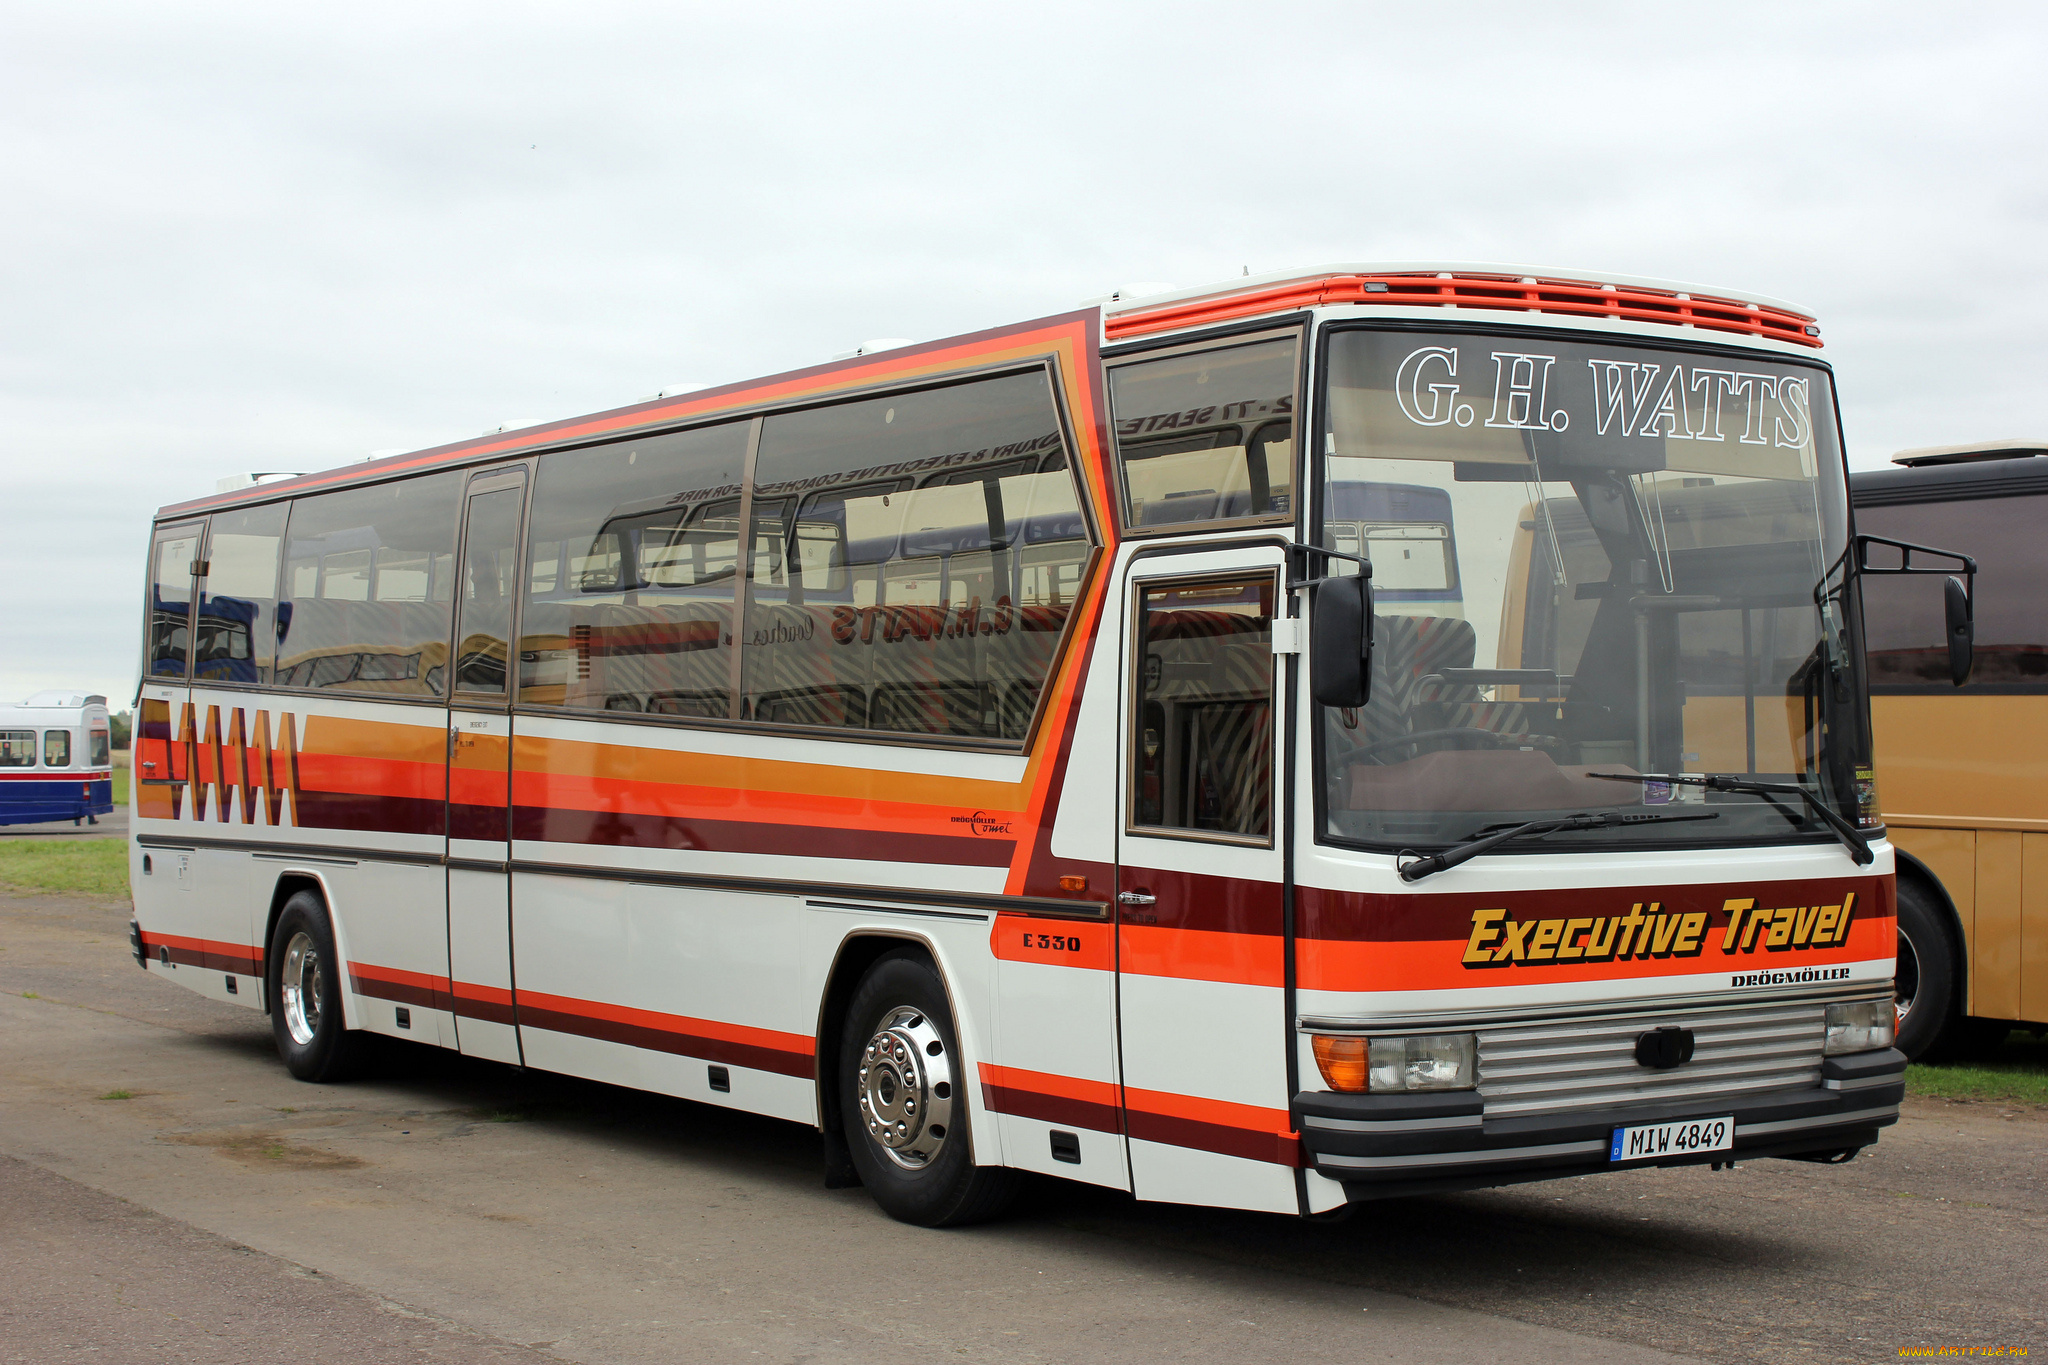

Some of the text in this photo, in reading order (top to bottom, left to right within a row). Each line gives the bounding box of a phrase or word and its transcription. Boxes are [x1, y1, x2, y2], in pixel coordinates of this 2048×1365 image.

[1587, 358, 1810, 449] WATTS
[970, 810, 1014, 836] Comet
[1023, 933, 1081, 952] E 330
[1461, 891, 1860, 970] Executive Travel
[1613, 1147, 1619, 1156] D
[1630, 1121, 1725, 1156] MIW 4849
